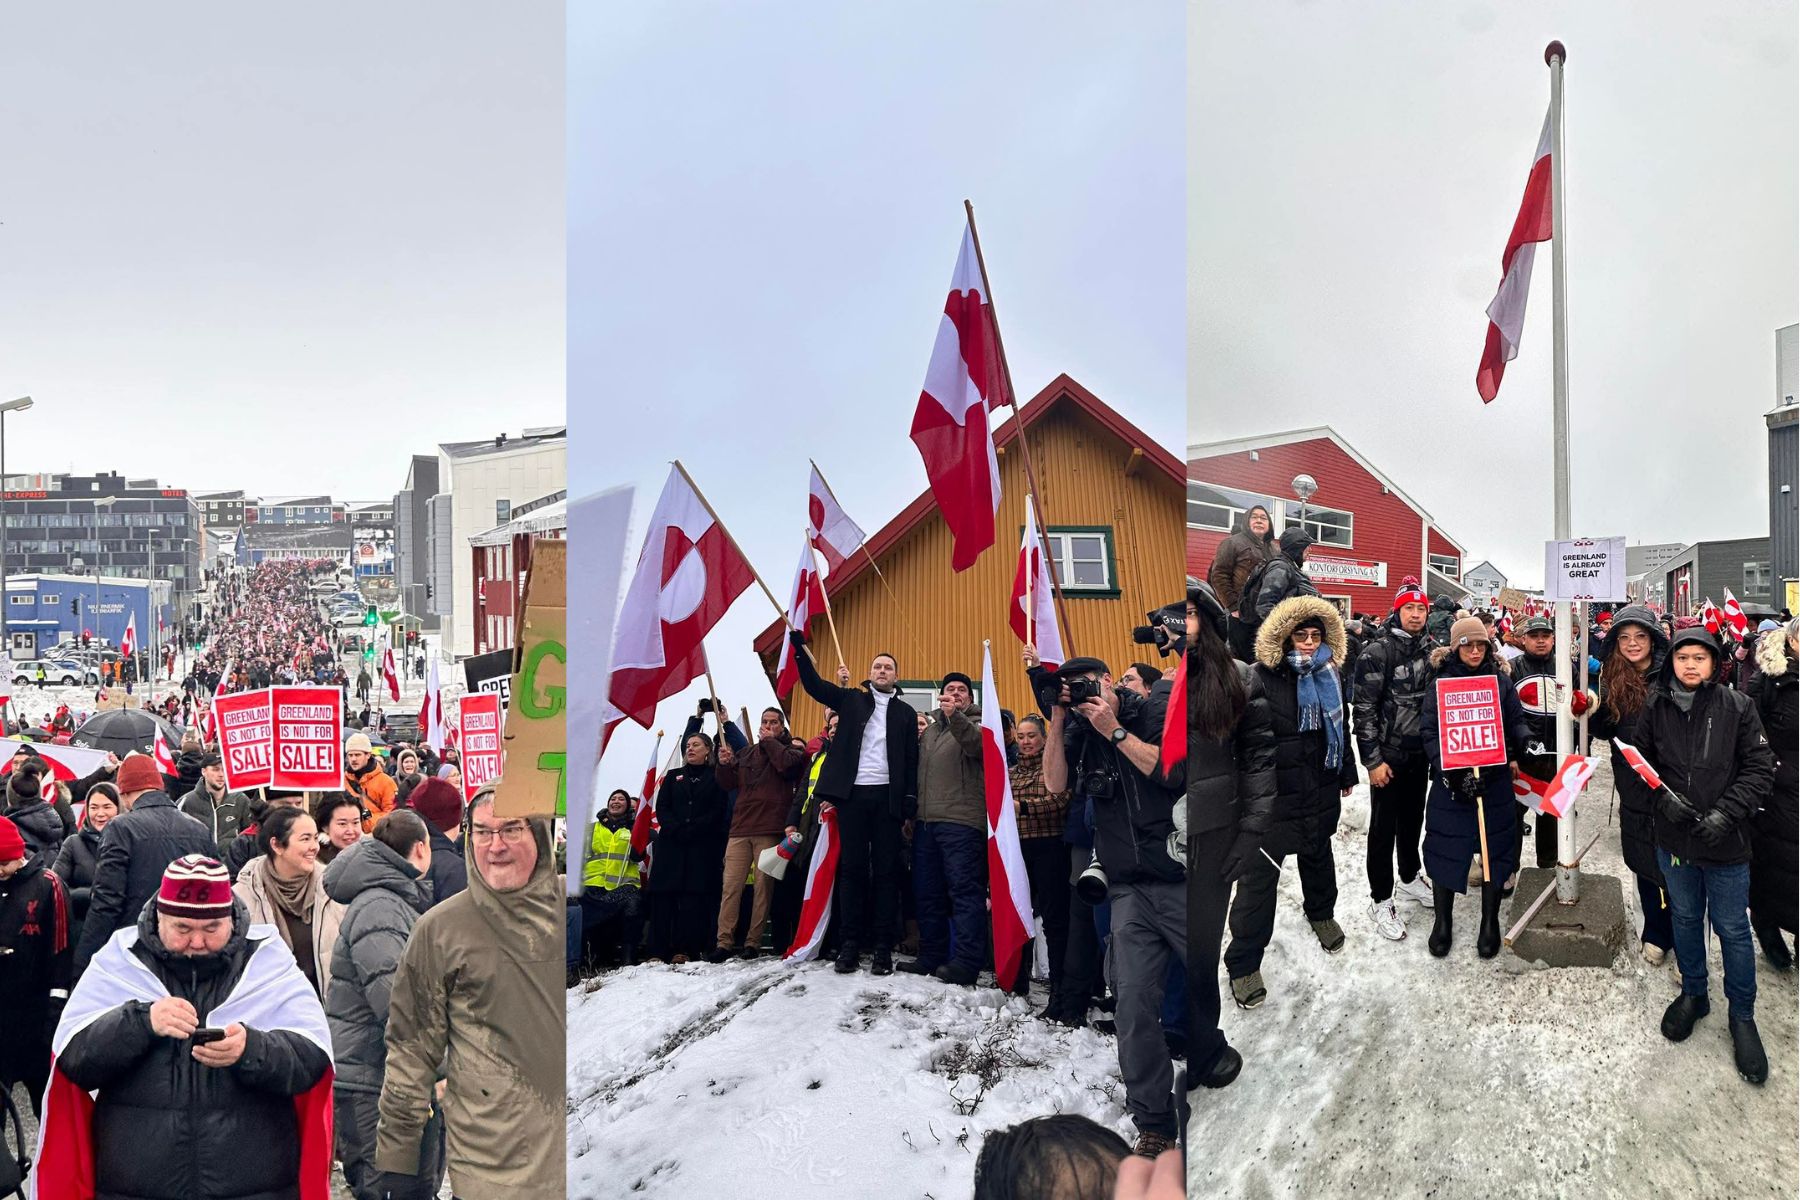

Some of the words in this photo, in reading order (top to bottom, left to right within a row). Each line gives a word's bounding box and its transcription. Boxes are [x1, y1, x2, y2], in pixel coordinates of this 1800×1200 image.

[1563, 553, 1607, 561] GREENLAND
[1309, 562, 1368, 576] KONTORFORSYNING
[1571, 561, 1606, 569] ALREADY
[1569, 570, 1600, 578] GREAT
[1446, 691, 1492, 705] GREENLAND
[225, 707, 270, 725] GREENLAN
[280, 706, 332, 719] GREENLAND
[1447, 711, 1455, 722] IS
[1458, 709, 1474, 721] NOT
[1478, 708, 1494, 720] FOR
[465, 714, 494, 729] GREENLAND
[229, 731, 237, 742] IS
[240, 728, 256, 740] NOT
[260, 725, 271, 737] FO
[281, 726, 289, 738] IS
[294, 726, 310, 738] NOT
[315, 726, 332, 738] FOR
[1448, 725, 1497, 752] SALE!
[467, 736, 472, 749] IS
[474, 736, 483, 749] NOT
[485, 735, 496, 749] FOR
[282, 745, 332, 770] SALE!
